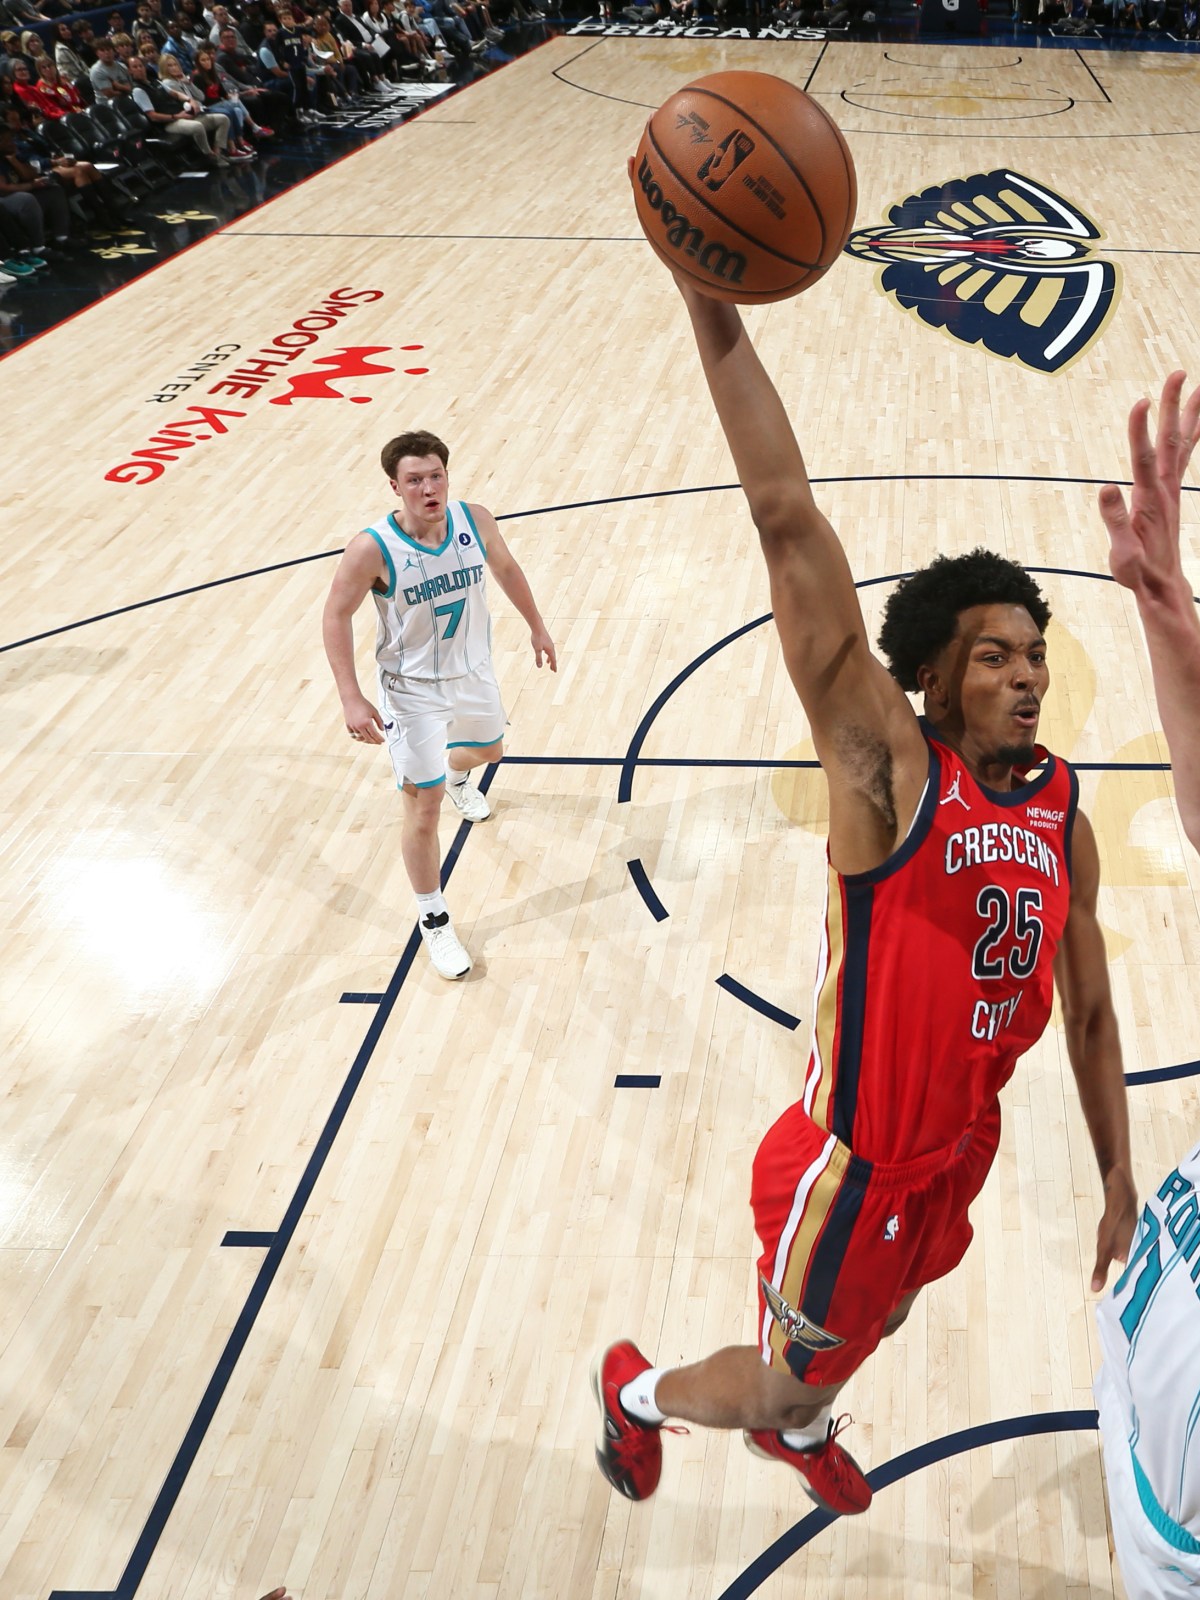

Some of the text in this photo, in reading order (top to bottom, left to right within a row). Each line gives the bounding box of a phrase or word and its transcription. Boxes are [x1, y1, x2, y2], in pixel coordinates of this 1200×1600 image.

[566, 24, 827, 40] PELICANS
[637, 152, 748, 285] Wilson
[207, 287, 385, 400] SMOOTHIE
[145, 343, 242, 404] CENTER
[402, 564, 483, 606] CHARLOTTE
[434, 597, 467, 641] 7
[1026, 806, 1065, 823] NEWAGE
[1029, 820, 1058, 831] PRODUCTS
[945, 822, 1059, 887] CRESCENT
[971, 884, 1044, 980] 25
[971, 990, 1023, 1042] CITY
